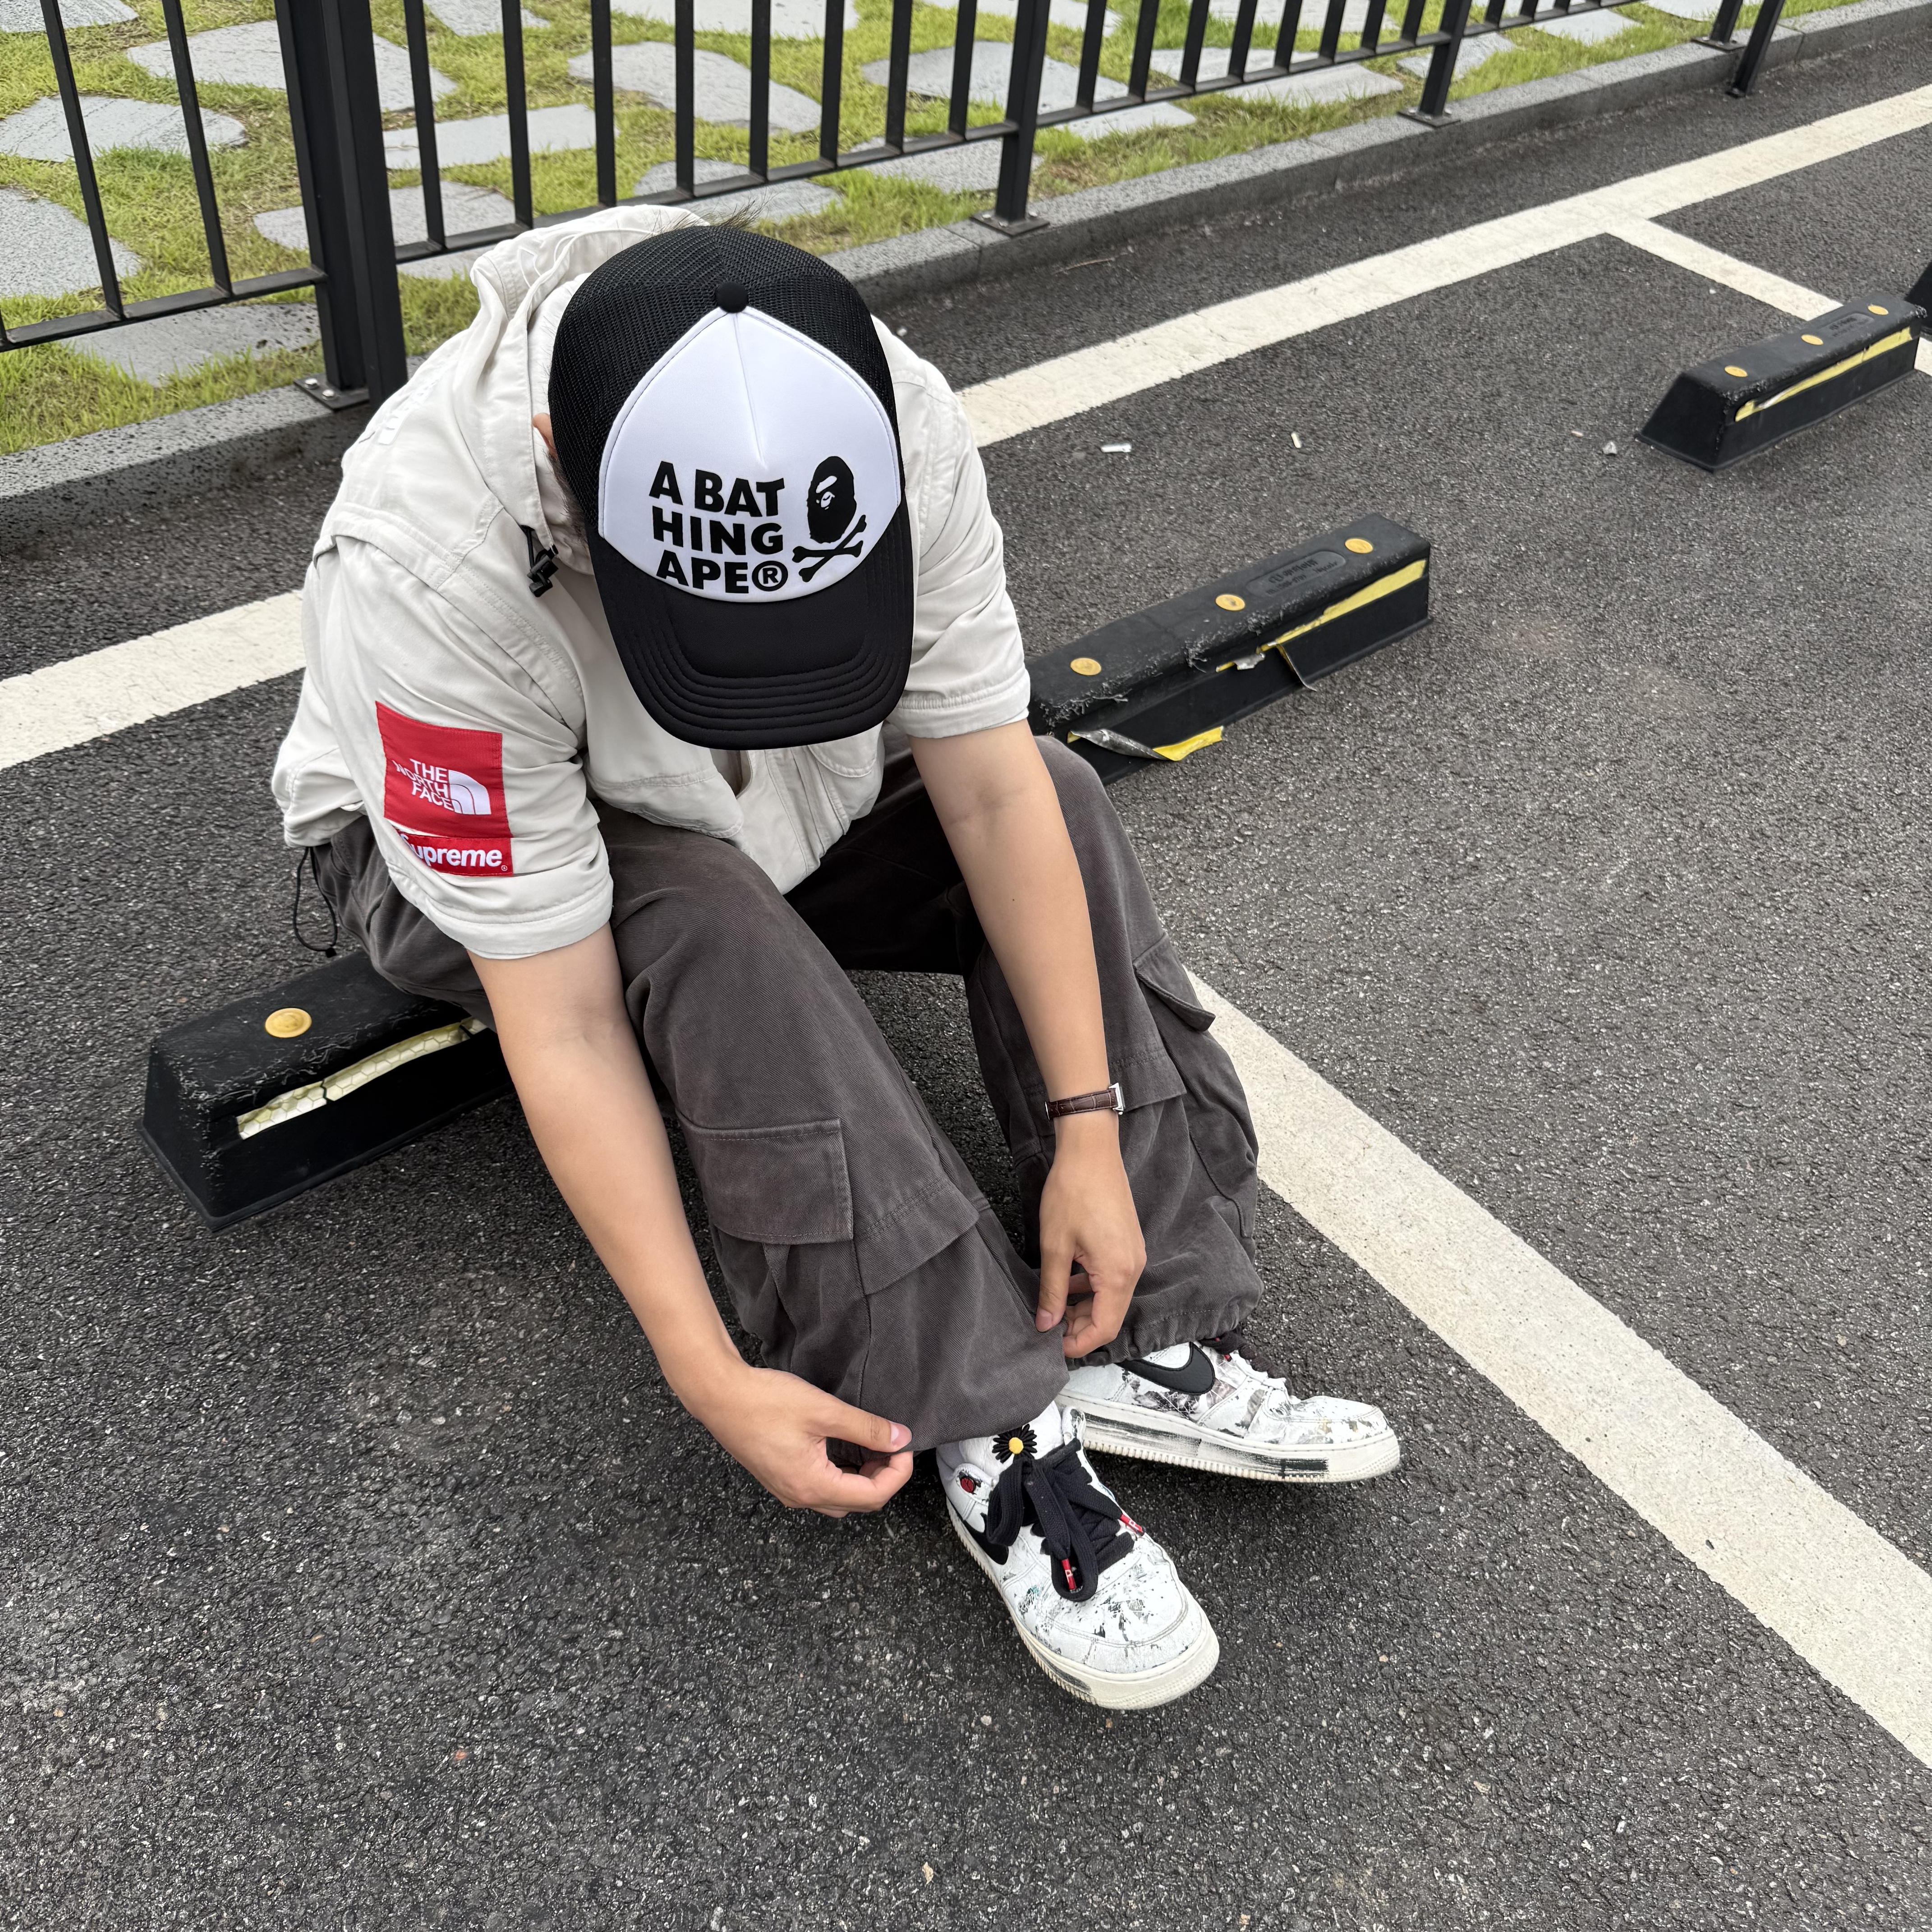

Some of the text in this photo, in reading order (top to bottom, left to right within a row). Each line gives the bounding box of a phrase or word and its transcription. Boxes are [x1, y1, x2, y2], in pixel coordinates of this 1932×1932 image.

[649, 460, 785, 517] A BAT
[652, 505, 783, 556] HING
[391, 760, 449, 798] NORTH
[409, 758, 448, 783] THE
[412, 781, 454, 811] FACE
